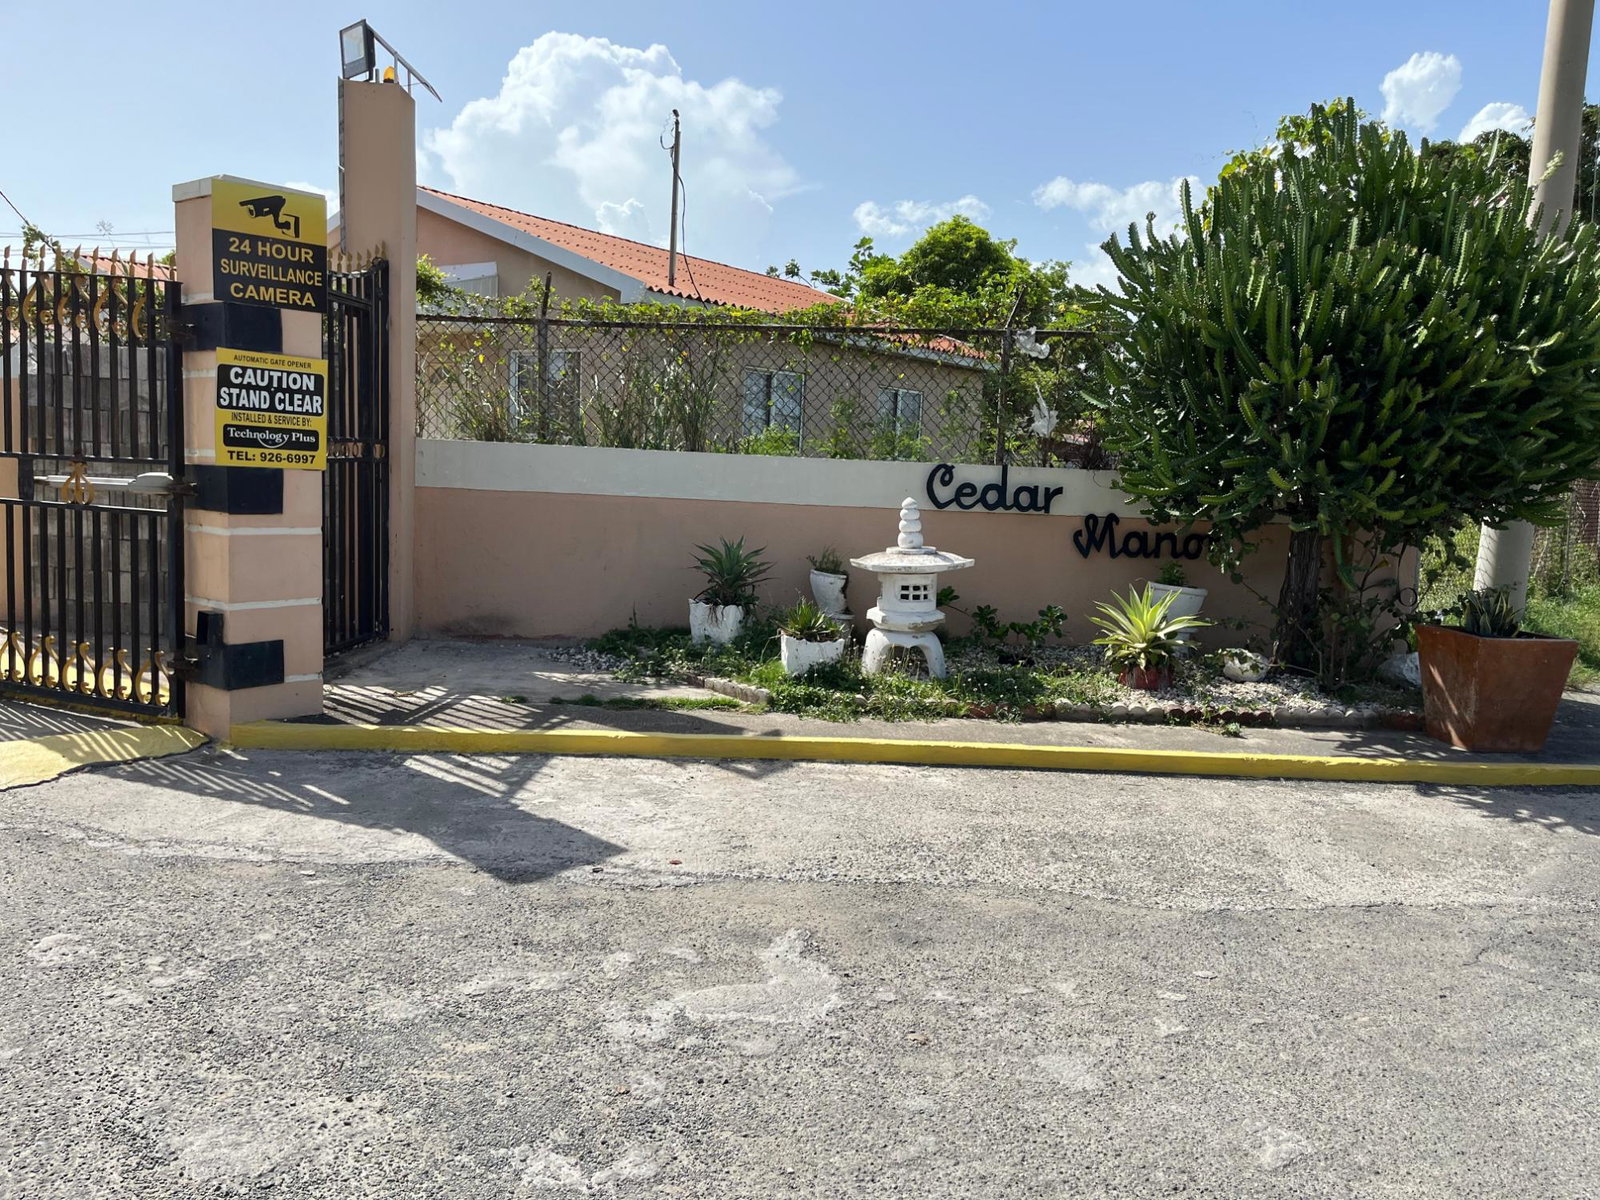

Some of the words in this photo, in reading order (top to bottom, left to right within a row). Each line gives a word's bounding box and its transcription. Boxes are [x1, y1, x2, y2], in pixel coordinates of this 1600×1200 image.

[229, 238, 251, 254] 24
[257, 241, 314, 264] HOUR
[221, 258, 322, 286] SURVEILLANCE
[230, 282, 316, 307] CAMERA
[233, 355, 269, 364] AUTOMATIC
[270, 358, 285, 366] GATE
[287, 360, 311, 369] OPENER
[230, 367, 315, 391] CAUTION
[220, 387, 270, 409] STAND
[274, 392, 322, 413] CLEAR
[231, 412, 266, 423] INSTALLED
[268, 416, 273, 424] &
[273, 416, 300, 426] SERVICE
[302, 418, 312, 427] BY:
[227, 427, 290, 443] Technology
[291, 432, 316, 443] Plus
[227, 450, 256, 461] TEL:
[260, 452, 316, 464] 926-6997
[926, 463, 1064, 514] Cedar
[1073, 512, 1212, 560] Mano
